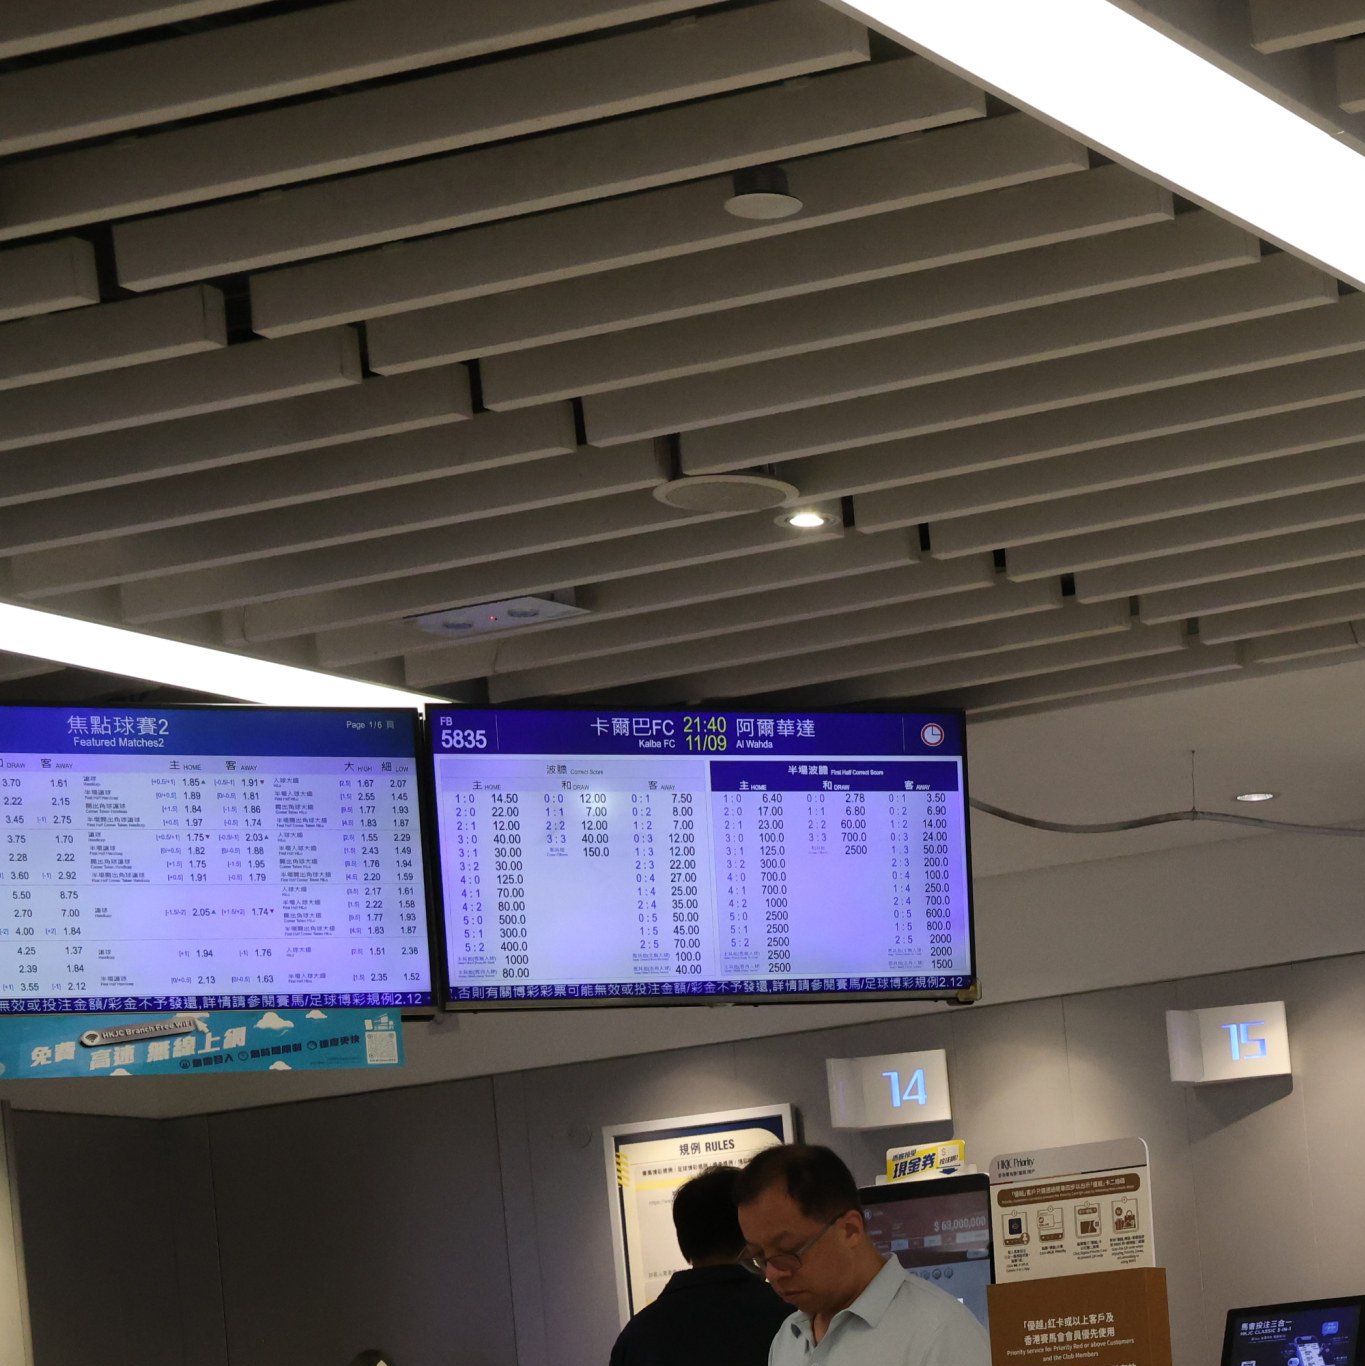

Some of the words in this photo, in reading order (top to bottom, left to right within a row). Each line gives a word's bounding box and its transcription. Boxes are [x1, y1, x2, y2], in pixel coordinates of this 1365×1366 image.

[67, 715, 170, 736] 焦點球賽2
[440, 716, 453, 726] FB
[590, 717, 675, 736] 卡爾巴FC
[683, 716, 727, 733] 21:40
[736, 718, 816, 737] 阿爾華達
[73, 737, 116, 747] Featured
[119, 738, 165, 748] Matches2
[441, 730, 488, 749] 5835
[639, 739, 662, 748] Kalba
[664, 739, 676, 748] FC
[685, 735, 727, 751] 11/09
[746, 740, 773, 748] Wahda
[2, 779, 21, 787] 3.70
[50, 779, 68, 788] 1.61
[182, 778, 200, 787] 1.85
[491, 794, 518, 804] 14.50
[671, 794, 692, 803] 7.50
[845, 793, 865, 803] 2.78
[926, 793, 946, 803] 3.50
[840, 819, 866, 829] 60.00
[768, 963, 791, 973] 2500
[102, 1029, 125, 1040] HKJC
[126, 1025, 154, 1036] Branch
[155, 1023, 174, 1032] Free
[1221, 1021, 1267, 1061] 15
[882, 1068, 927, 1108] 14
[680, 1143, 701, 1156] 規例
[705, 1139, 735, 1152] RULES
[892, 1153, 936, 1179] 現金券
[1013, 1157, 1035, 1168] Priority
[1007, 1349, 1026, 1357] Priority
[1053, 1344, 1072, 1352] Priority
[1107, 1338, 1135, 1347] Customers
[1043, 1354, 1053, 1362] and
[1053, 1353, 1062, 1361] the
[1063, 1352, 1075, 1360] Club
[1075, 1351, 1099, 1359] Members
